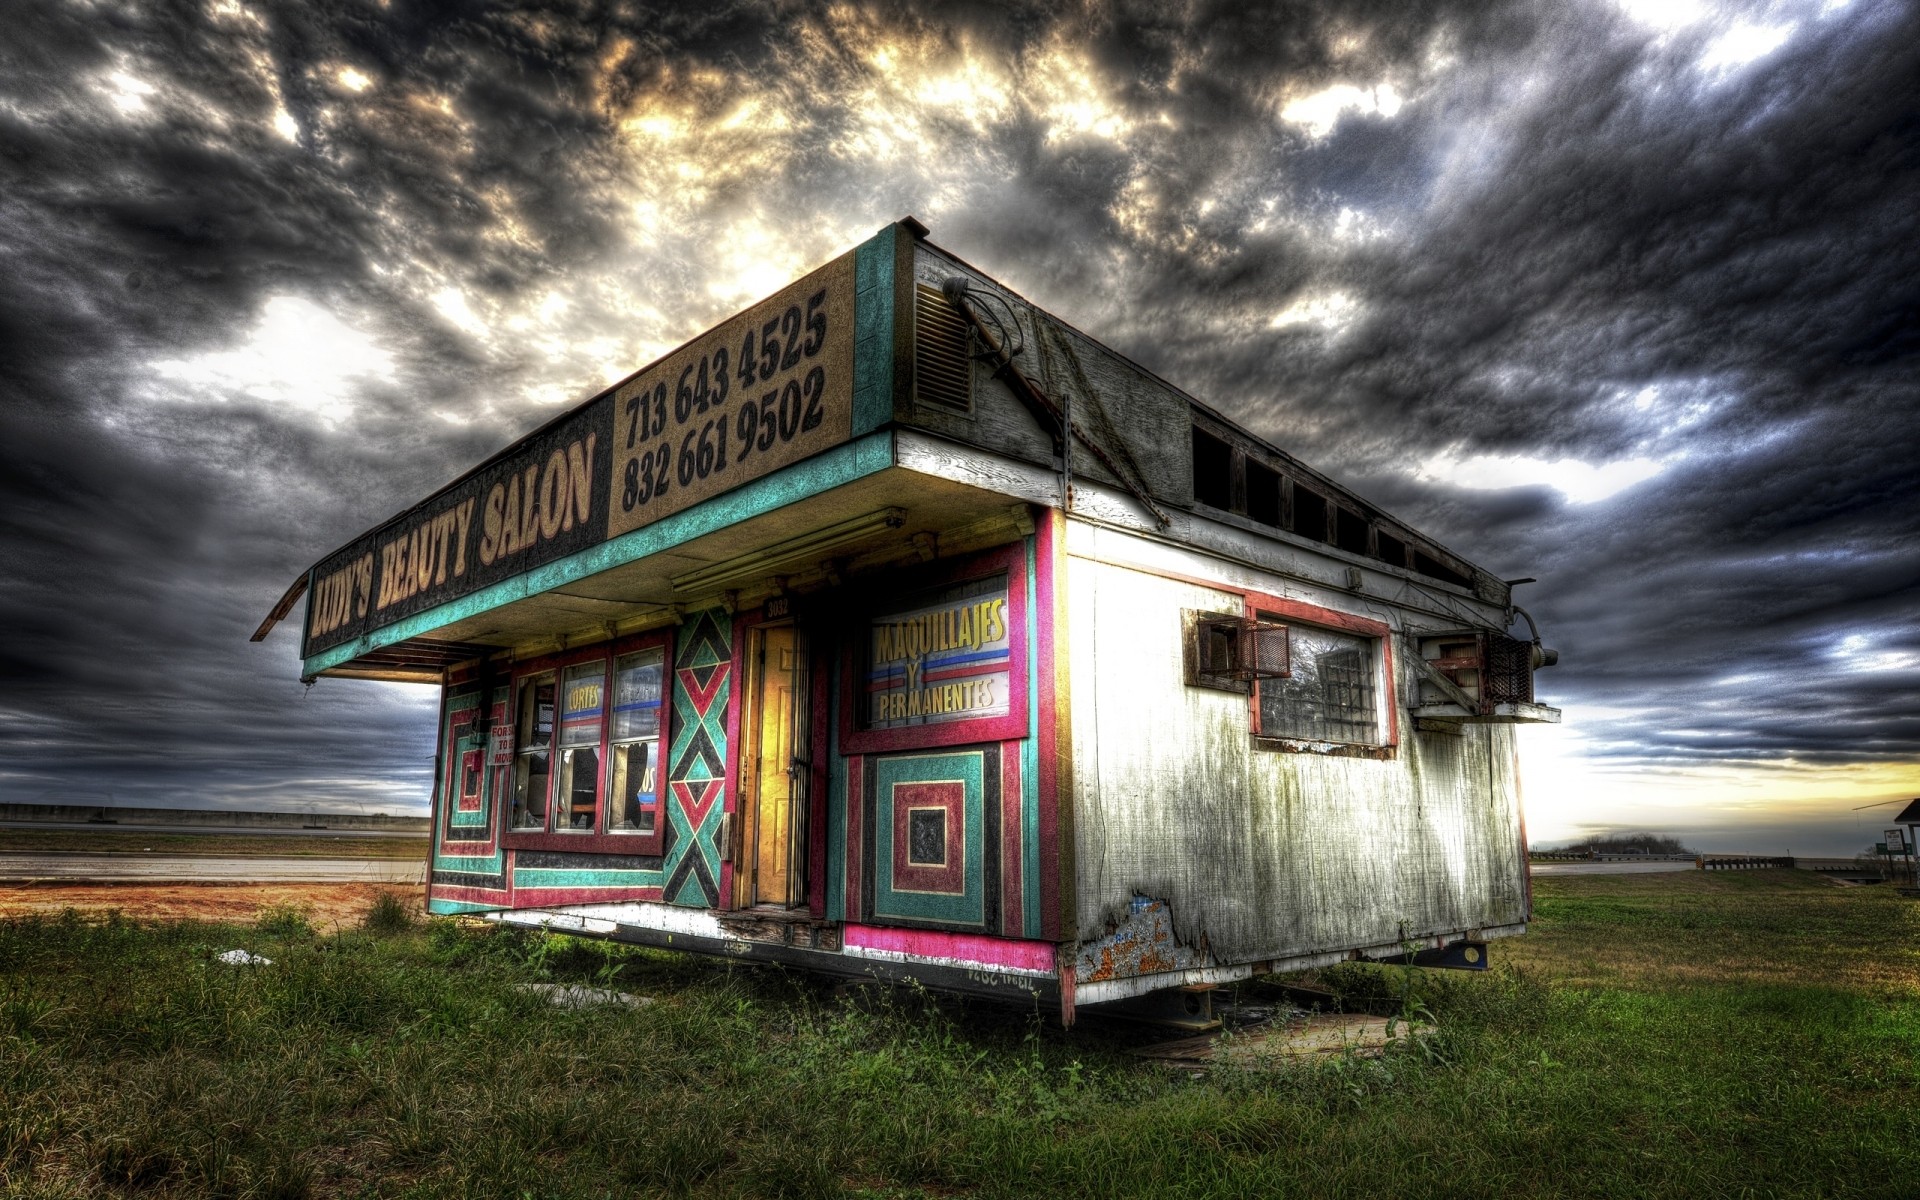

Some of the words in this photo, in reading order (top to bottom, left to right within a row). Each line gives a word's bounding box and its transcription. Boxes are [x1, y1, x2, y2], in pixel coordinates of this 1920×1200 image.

[625, 381, 668, 450] 713
[674, 347, 730, 425] 643
[737, 288, 827, 389] 4525
[621, 442, 672, 513] 832
[677, 413, 728, 488] 661
[736, 365, 826, 473] 9502
[310, 551, 374, 639] LUDY'S
[376, 495, 476, 611] BEAUTY
[478, 431, 598, 567] SALON
[767, 597, 789, 618] 3032
[875, 598, 1005, 664] MAQUILLAJES
[906, 662, 920, 689] Y
[569, 684, 600, 711] CORTES
[879, 679, 993, 721] PERMANENTES
[492, 728, 507, 737] FOR
[499, 740, 507, 750] TO
